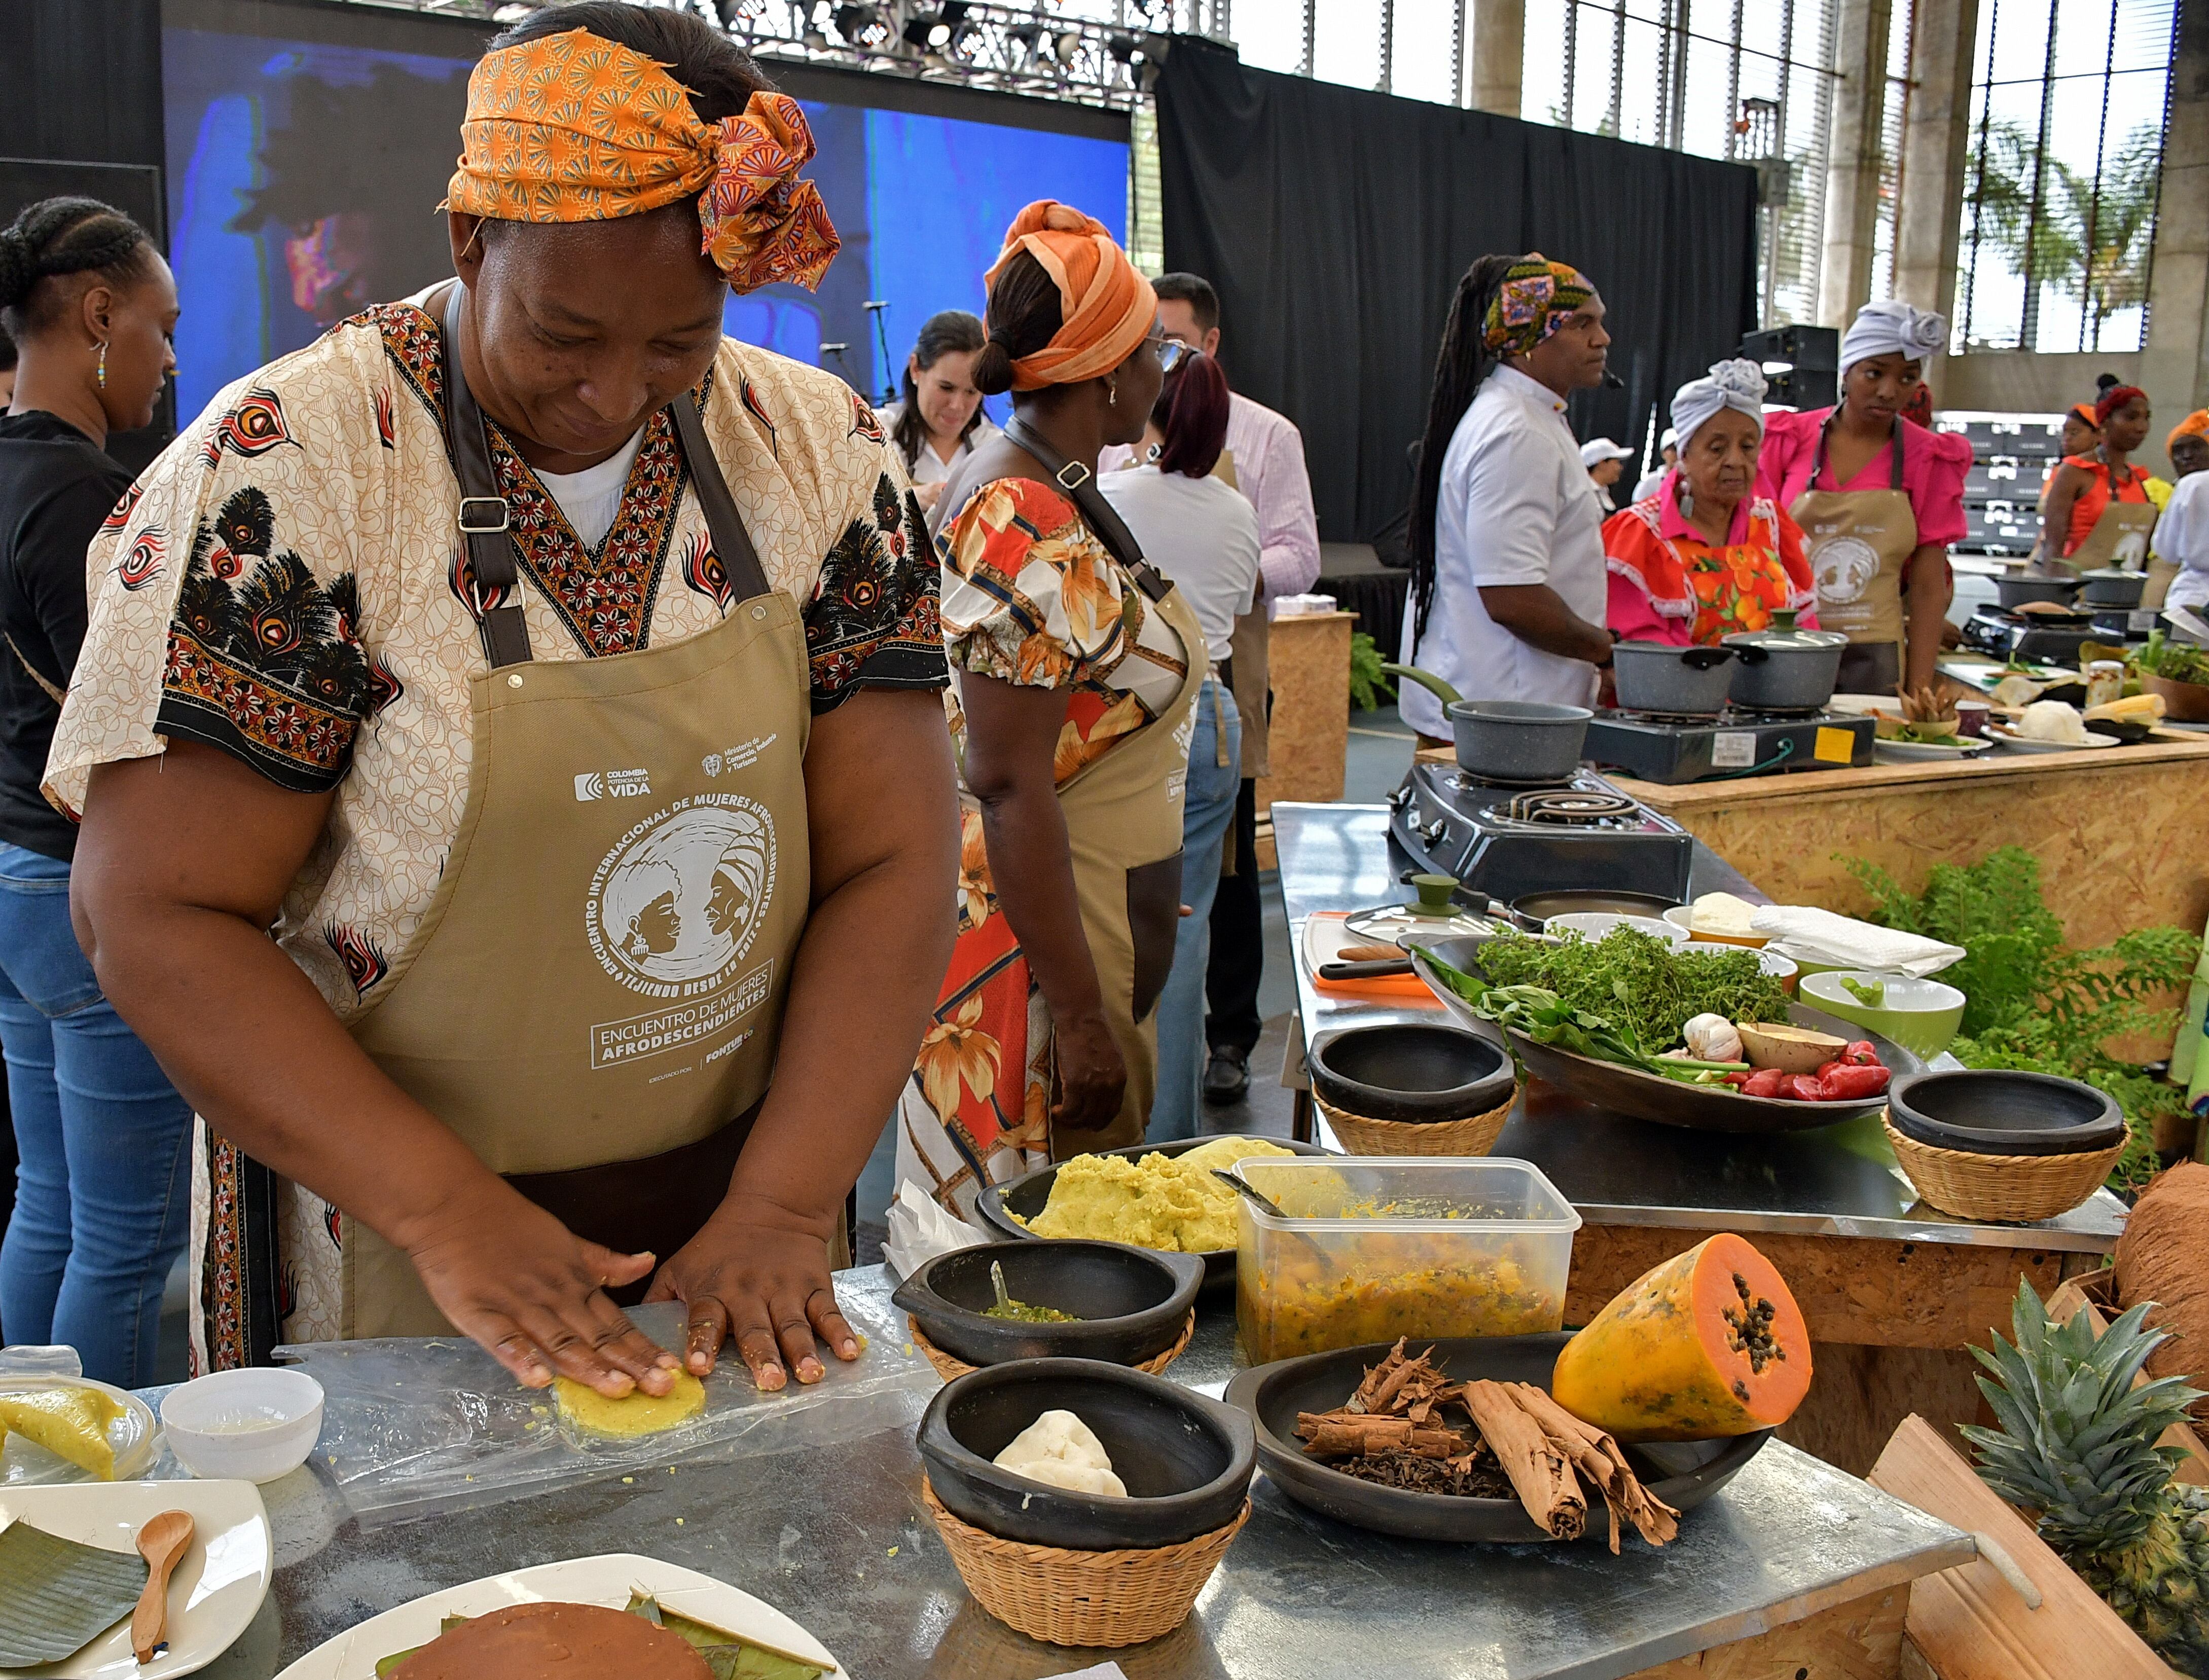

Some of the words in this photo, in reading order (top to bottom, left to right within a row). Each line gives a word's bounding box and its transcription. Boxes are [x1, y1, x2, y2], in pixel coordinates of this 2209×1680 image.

[724, 741, 752, 757] Ministerio
[726, 748, 757, 764] Comercio,
[756, 733, 777, 751] Industria
[606, 768, 648, 779] COLOMBIA
[733, 756, 757, 770] Turismo
[608, 782, 651, 797] VIDA
[693, 793, 751, 809] MUJERES
[672, 797, 690, 812] DE
[588, 808, 670, 897] INTERNACIONAL
[749, 801, 777, 918] AFRODESCENDIENTES
[585, 899, 619, 976] ENCUENTRO
[621, 973, 679, 998] TEJIENDO
[684, 972, 722, 997] DESDE
[600, 1009, 695, 1045] ENCUENTRO
[699, 1000, 718, 1020] DE
[720, 968, 769, 1010] MUJERES
[601, 984, 767, 1061] AFRODESCENDIENTES
[706, 1034, 743, 1064] FONTUR
